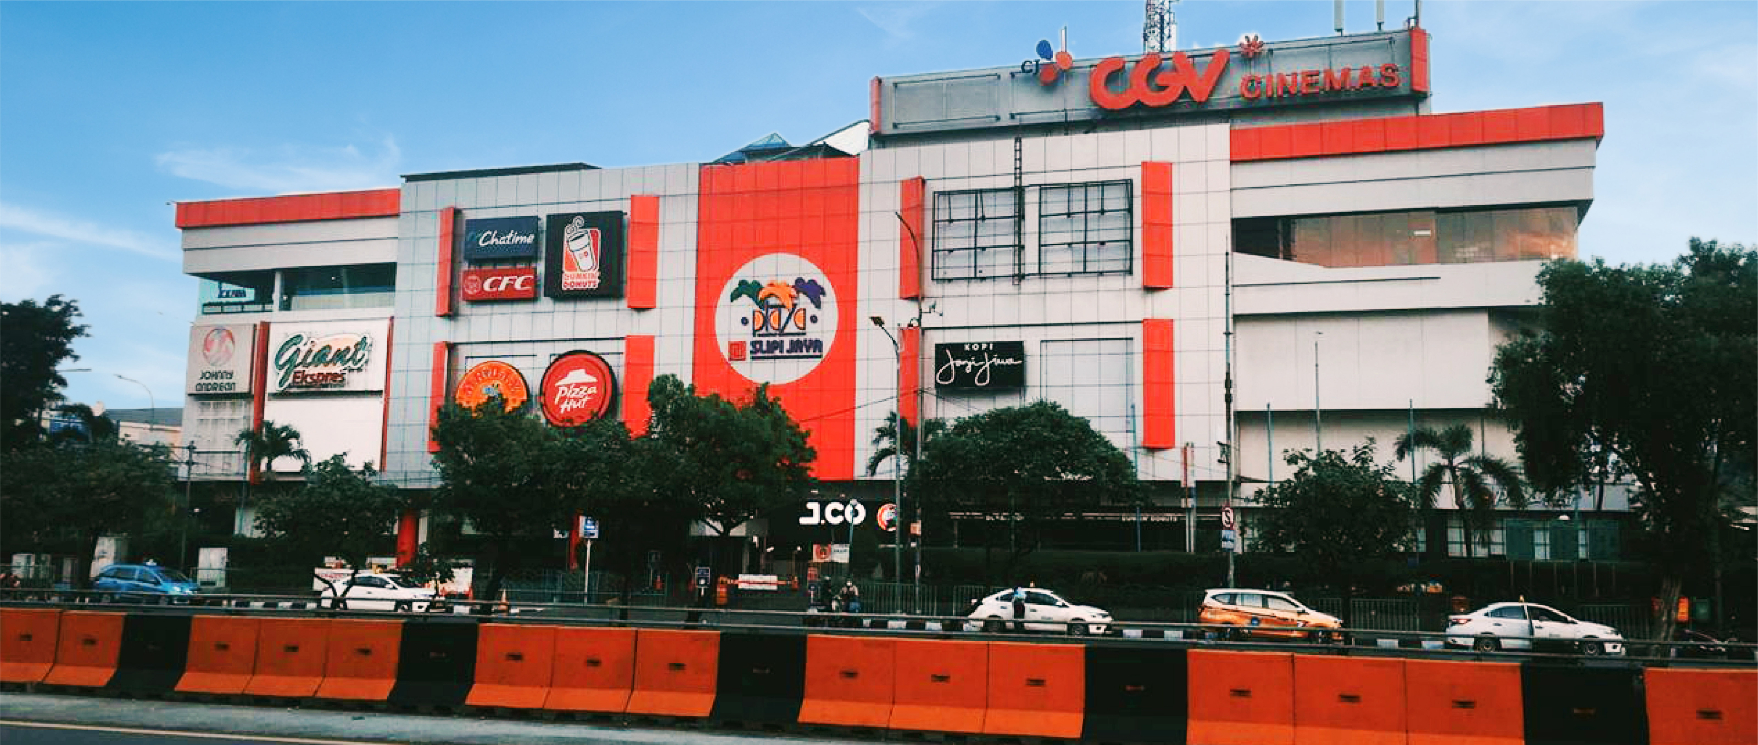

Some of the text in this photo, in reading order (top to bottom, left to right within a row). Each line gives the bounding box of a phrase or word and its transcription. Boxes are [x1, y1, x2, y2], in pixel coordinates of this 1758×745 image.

[1020, 58, 1041, 75] CJ
[1089, 48, 1400, 111] CGV CINEMAS
[478, 230, 535, 247] Chatime
[482, 275, 534, 292] CFC
[749, 338, 824, 354] SLIPI JAYA
[963, 343, 994, 351] KOPI
[274, 333, 370, 389] Giant
[292, 369, 346, 385] Ekspres
[554, 383, 598, 405] Pizza
[560, 397, 590, 415] Hut
